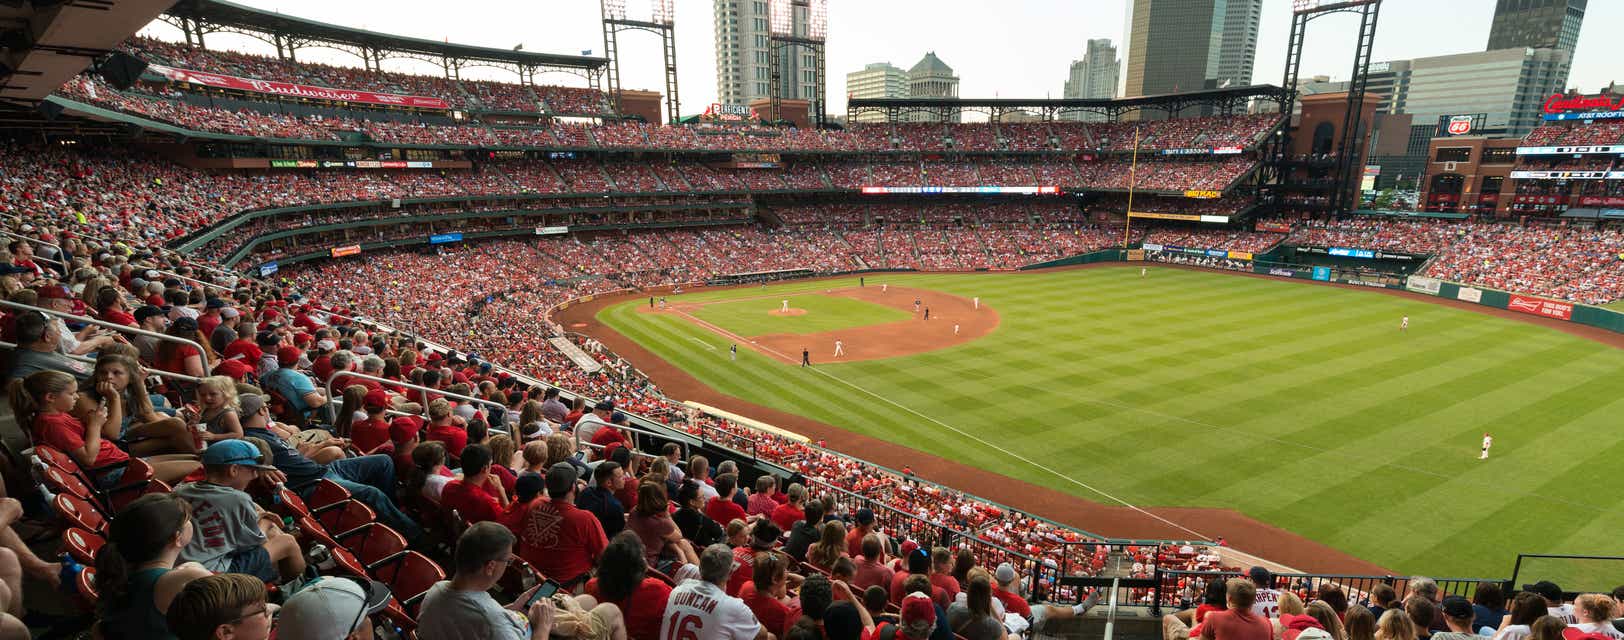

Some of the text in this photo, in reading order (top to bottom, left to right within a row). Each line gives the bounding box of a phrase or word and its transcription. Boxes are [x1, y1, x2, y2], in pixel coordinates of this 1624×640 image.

[252, 80, 358, 100] Budweiser
[674, 591, 718, 614] DUNCAN
[667, 611, 703, 640] 16
